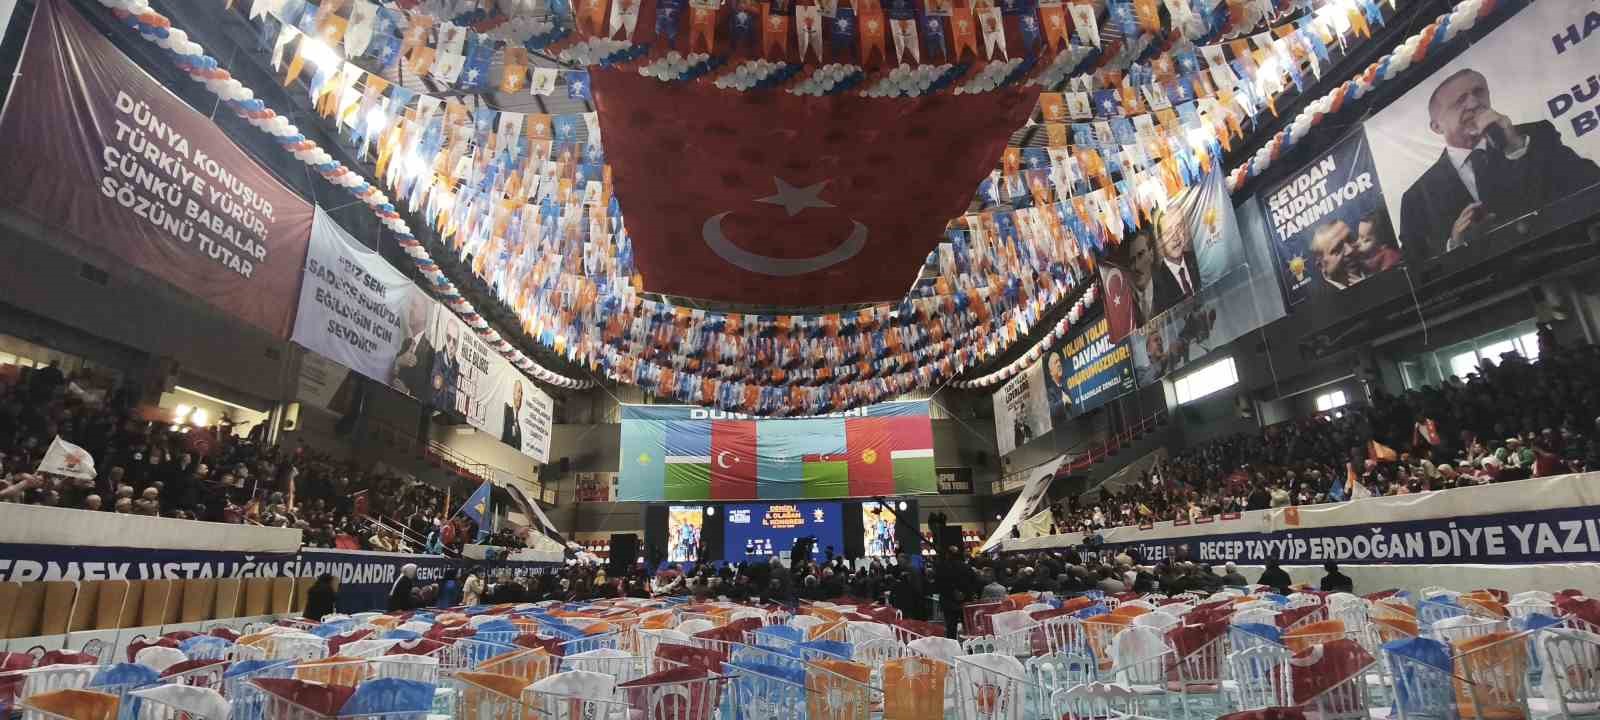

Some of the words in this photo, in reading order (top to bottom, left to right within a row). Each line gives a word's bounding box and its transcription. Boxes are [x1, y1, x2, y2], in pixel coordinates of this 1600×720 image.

[1552, 11, 1600, 55] HA
[1547, 74, 1600, 119] DÜ
[115, 119, 204, 196] TÜRKİYE
[208, 185, 269, 241] YÜRÜR;
[116, 90, 189, 158] DÜNYA
[193, 149, 275, 223] KONUŞUR,
[1268, 154, 1336, 211] SEVDAN
[101, 177, 194, 243] SÖZÜNÜ
[198, 233, 253, 279] TUTAR
[103, 146, 182, 207] ÇÜNKÜ
[185, 200, 267, 262] BABALAR
[1272, 179, 1328, 227] HUDUT
[1276, 172, 1374, 242] TANIMIYOR
[1199, 541, 1242, 561] RECEP
[1248, 533, 1307, 560] TAYYİP
[1309, 527, 1424, 561] ERDOĞAN
[1428, 521, 1506, 558] DİYE
